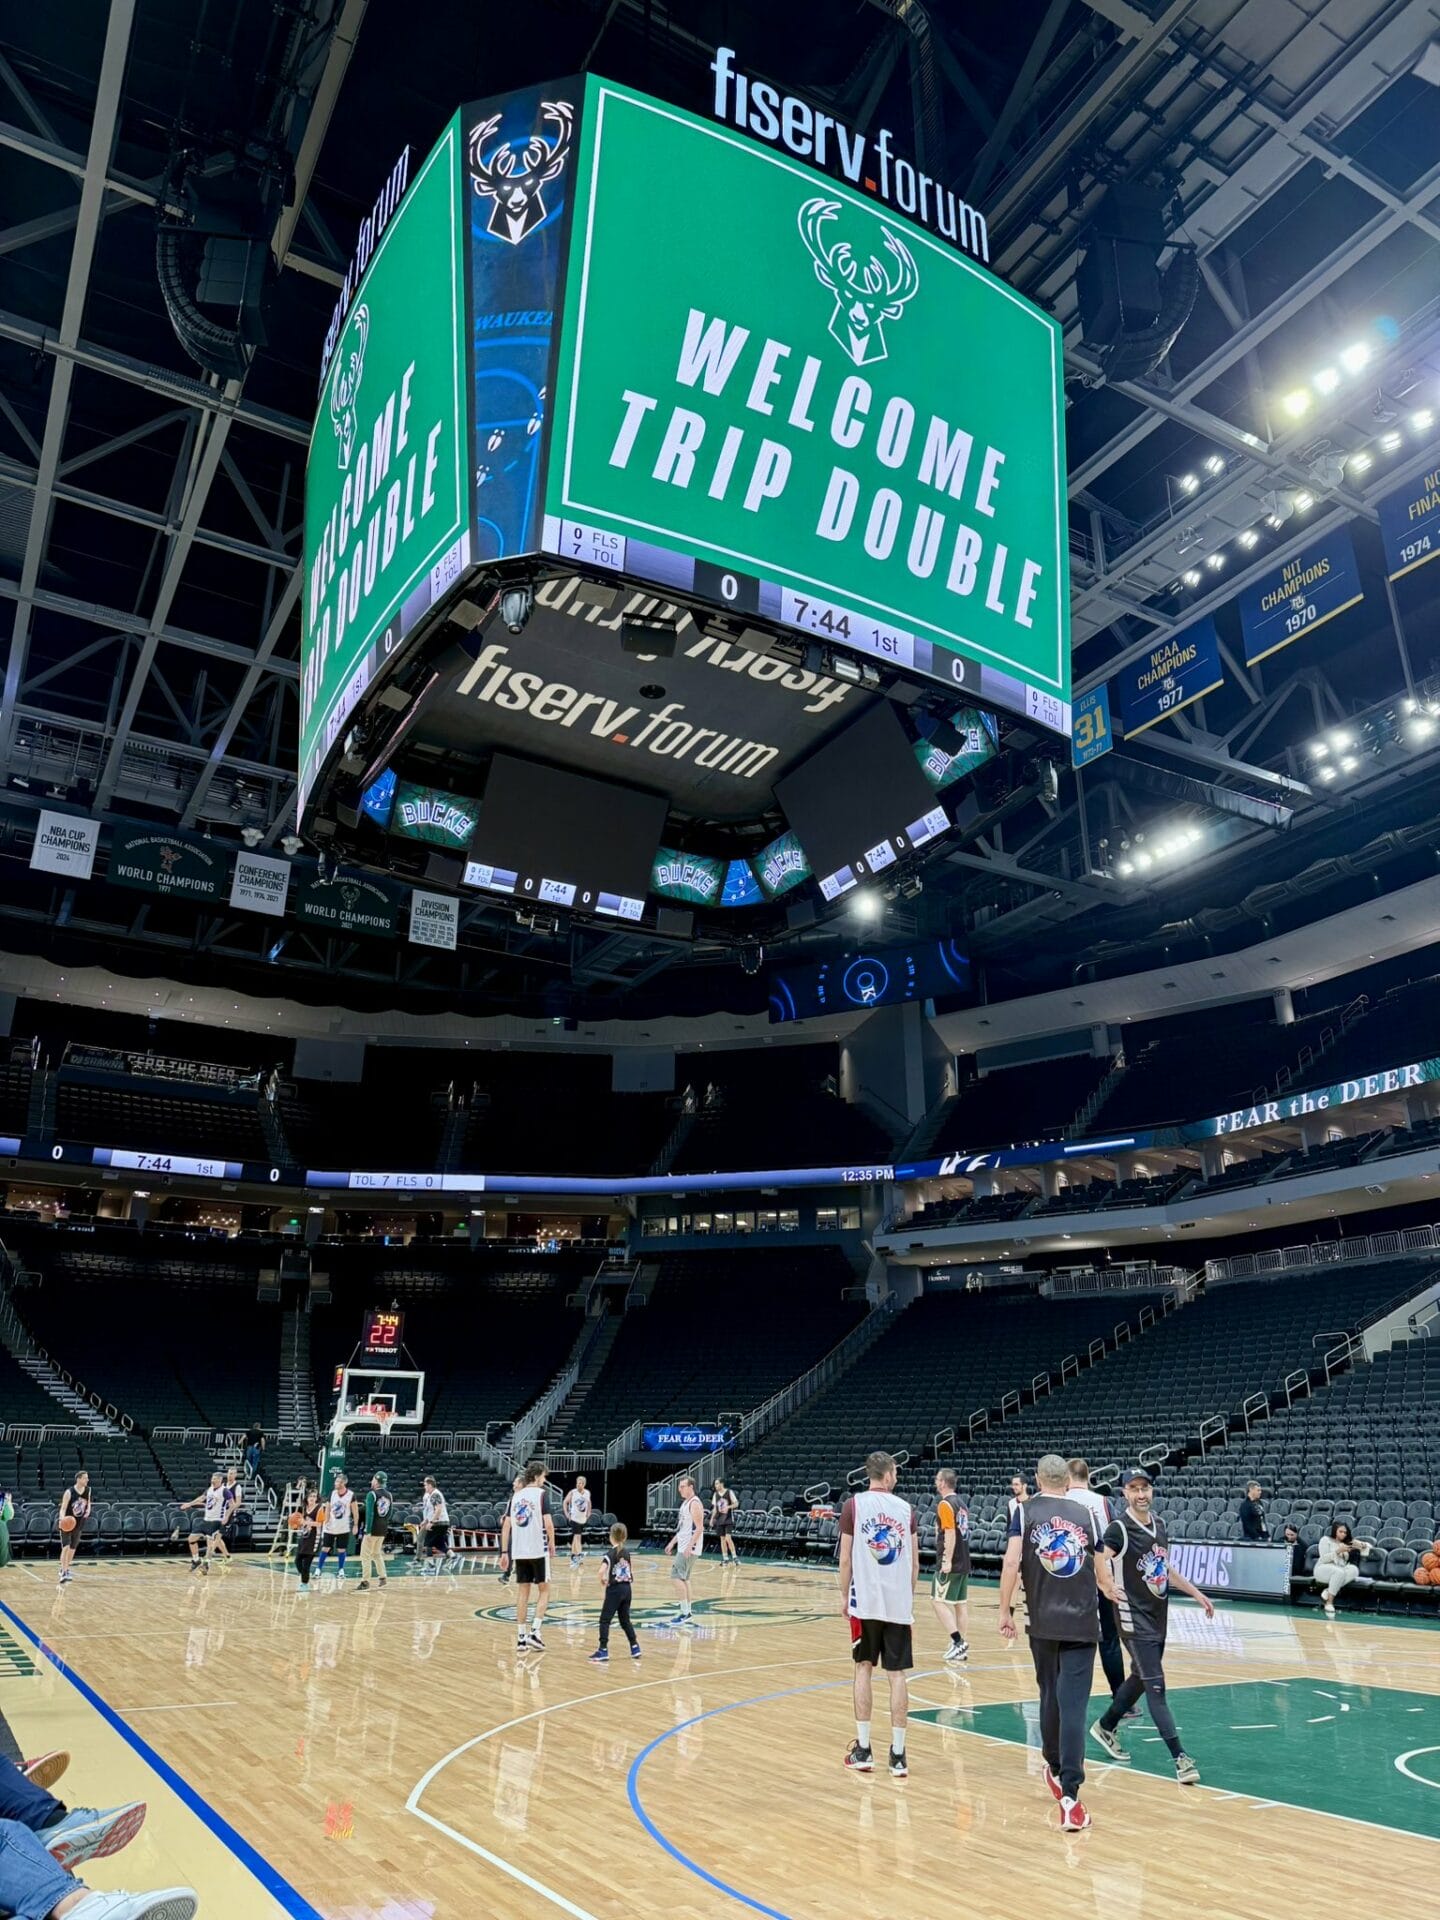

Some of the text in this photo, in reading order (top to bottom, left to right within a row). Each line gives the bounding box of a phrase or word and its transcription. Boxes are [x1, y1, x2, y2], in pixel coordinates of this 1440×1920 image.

[674, 308, 1006, 519] WELCOME
[310, 360, 415, 637] WELCOME
[608, 388, 1043, 629] TRIP DOUBLE
[335, 419, 442, 653] DOUBLE
[574, 527, 618, 550] 0 FLS
[573, 543, 618, 566] 7 TOL
[1400, 536, 1431, 563] 1974
[445, 564, 458, 583] TOL
[1282, 558, 1302, 582] NIT
[721, 575, 738, 600] 0
[1261, 558, 1330, 611] CHAMPIONS
[794, 598, 898, 655] 7:44 1st
[1285, 604, 1317, 633] 1970
[385, 628, 392, 653] 0
[1150, 640, 1180, 667] NCAA
[952, 658, 964, 682] 0
[1137, 644, 1197, 690] CHAMPIONS
[1033, 691, 1058, 712] 0 FLS
[1080, 695, 1096, 712] ELLIS
[1157, 686, 1183, 711] 1977
[1032, 704, 1059, 726] 7 TOL
[1074, 704, 1106, 749] 31
[927, 729, 980, 779] BUS
[401, 801, 472, 839] BUCKS
[41, 834, 91, 853] CHAMPIONS
[50, 825, 86, 841] NBA CUP
[125, 836, 150, 850] NATIONAL
[151, 836, 184, 849] BASKETBALL
[896, 836, 905, 849] 0
[56, 852, 70, 862] 2024
[867, 846, 886, 863] 7:44
[117, 864, 215, 893] WORLD CHAMPIONS
[238, 864, 287, 882] CONFERENCE
[478, 868, 490, 876] FLS
[764, 850, 803, 889] BUCKS
[856, 861, 865, 874] 0
[239, 874, 284, 892] CHAMPIONS
[524, 878, 533, 890] 0
[544, 881, 567, 895] 7:44
[657, 864, 715, 896] BUCKS
[421, 899, 450, 912] DIVISION
[582, 891, 591, 903] 0
[304, 902, 391, 929] WORLD CHAMPIONS
[415, 906, 455, 922] CHAMPIONS
[1214, 1064, 1424, 1136] FEAR the DEER
[52, 1146, 63, 1160] 0
[137, 1155, 213, 1175] 7:44 1st
[270, 1168, 280, 1182] 0
[841, 1168, 894, 1181] 12:35 PM
[355, 1175, 433, 1187] TOL 7 FLS 0
[376, 1314, 399, 1326] 7:44
[370, 1325, 395, 1344] 22
[658, 1434, 724, 1443] FEAR the DEER
[861, 1512, 905, 1539] Trip Double
[1030, 1516, 1088, 1546] Trip Double
[1136, 1551, 1154, 1572] Trip
[1170, 1544, 1232, 1586] BUCKS
